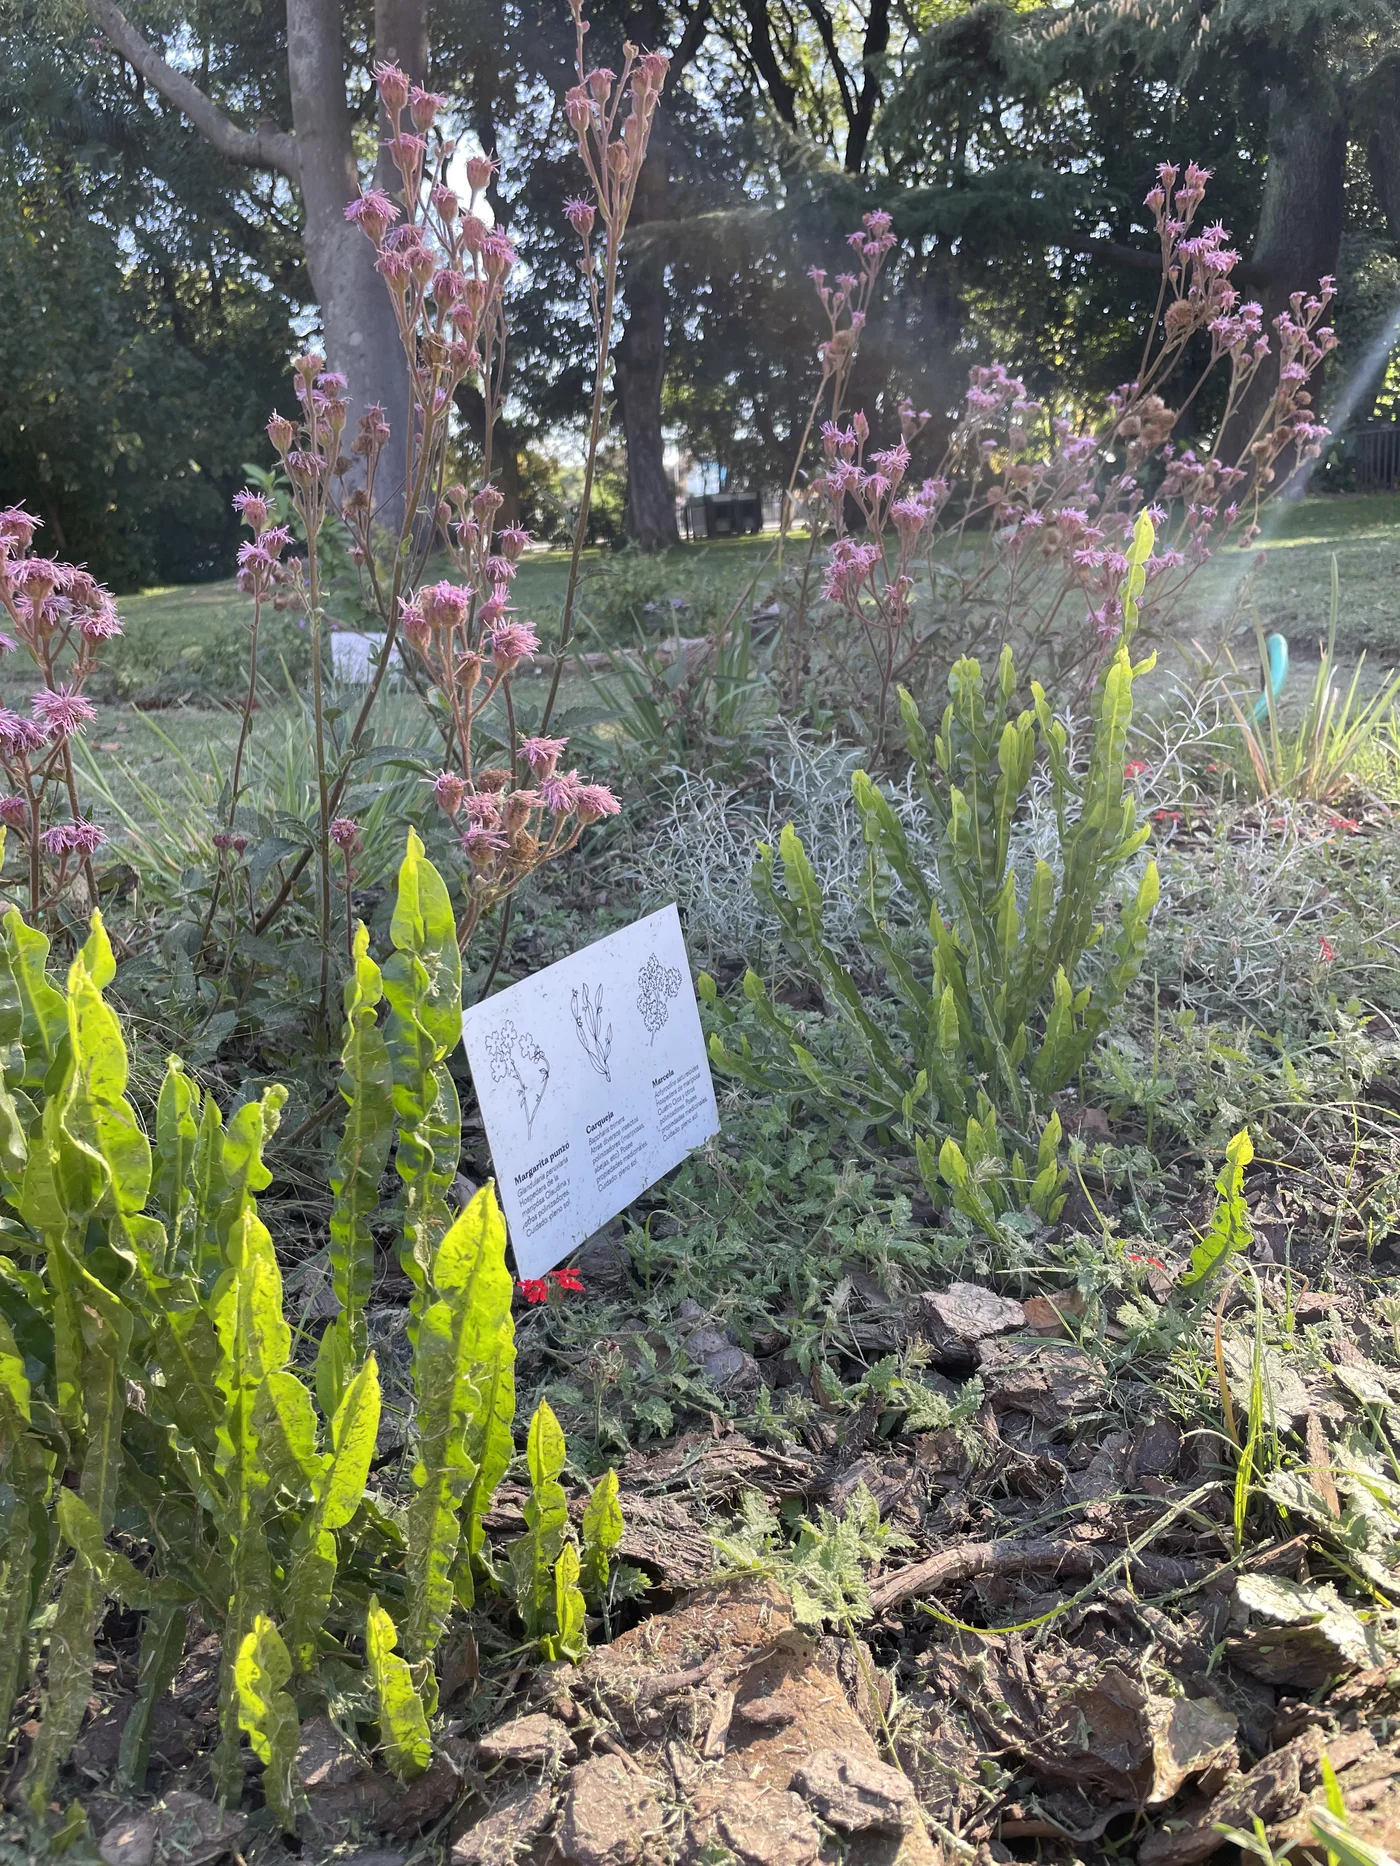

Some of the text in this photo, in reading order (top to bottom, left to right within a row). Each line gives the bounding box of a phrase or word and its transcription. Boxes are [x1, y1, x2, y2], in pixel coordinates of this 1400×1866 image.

[652, 1068, 674, 1088] Marcela
[658, 1101, 672, 1117] Cuatro
[685, 1086, 695, 1097] otros
[685, 1093, 697, 1107] Posee
[586, 1109, 614, 1136] Carqueja
[681, 1117, 692, 1130] pleno
[590, 1116, 639, 1155] Atrae diversos insectos
[620, 1140, 633, 1154] Posee
[514, 1156, 549, 1186] Margarita
[596, 1158, 623, 1184] propiedades
[618, 1164, 630, 1178] pleno
[519, 1183, 547, 1208] Hospedera
[522, 1196, 545, 1218] mariposa
[545, 1179, 567, 1200] Claudina
[524, 1212, 538, 1228] otros
[548, 1205, 563, 1222] pleno
